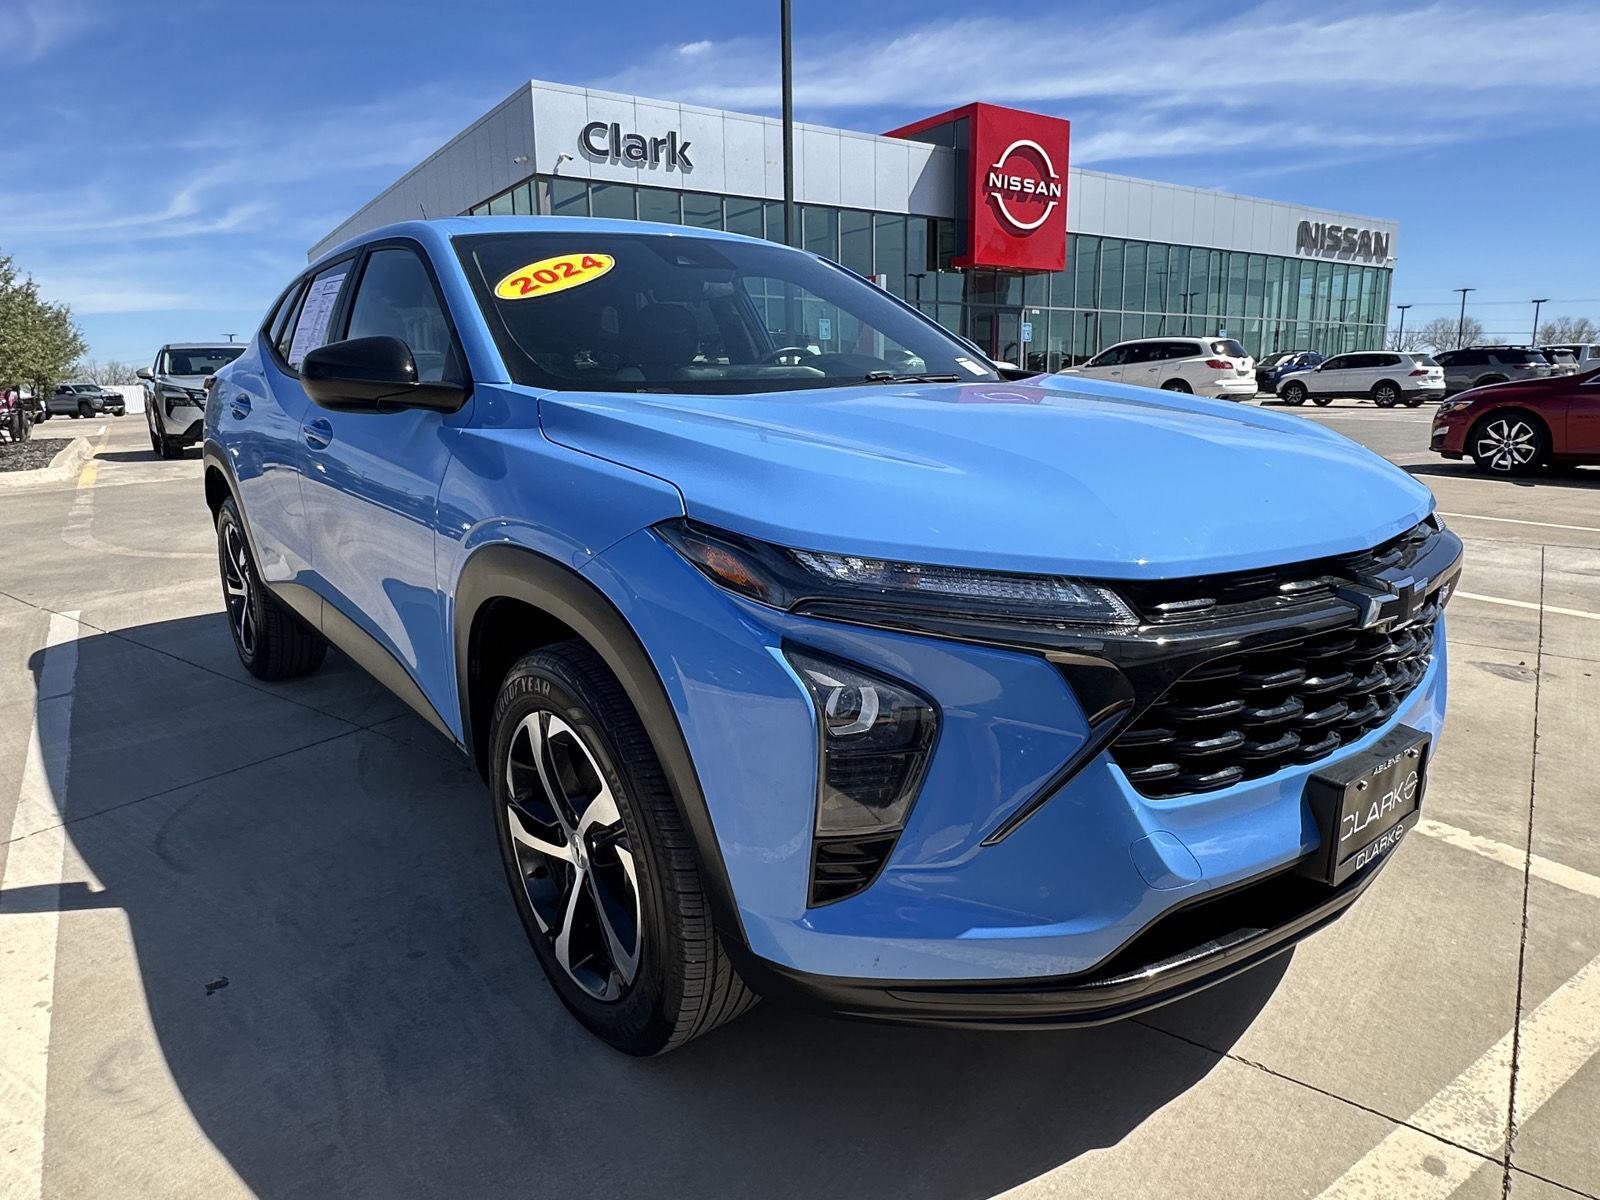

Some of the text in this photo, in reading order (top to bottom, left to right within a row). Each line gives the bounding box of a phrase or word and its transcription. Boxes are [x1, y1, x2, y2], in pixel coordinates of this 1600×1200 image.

[578, 121, 694, 172] Clark
[989, 171, 1062, 198] NISSAN
[1297, 220, 1390, 259] NISSAN
[509, 255, 605, 296] 2024
[1340, 780, 1405, 842] CLARK
[1355, 829, 1399, 871] CLARK
